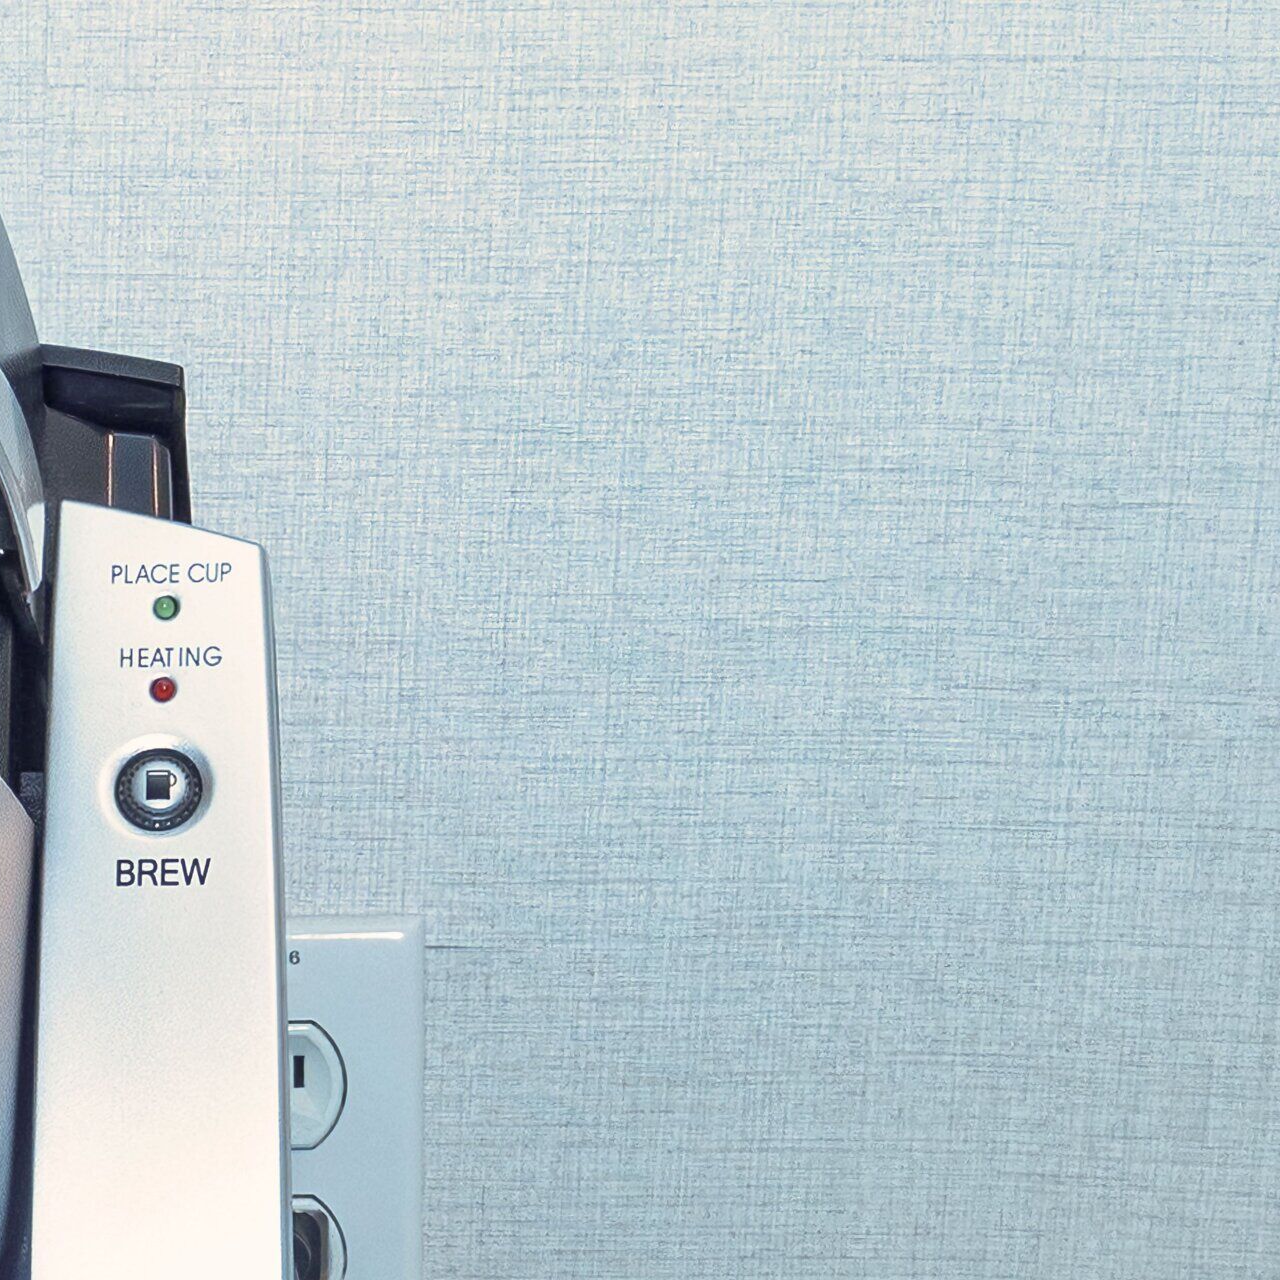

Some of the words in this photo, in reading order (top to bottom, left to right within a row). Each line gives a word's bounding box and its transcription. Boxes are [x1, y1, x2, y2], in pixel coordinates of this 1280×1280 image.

[111, 564, 181, 585] PLACE
[187, 562, 233, 583] CUP
[119, 646, 224, 668] HEATING
[116, 858, 212, 887] BREW
